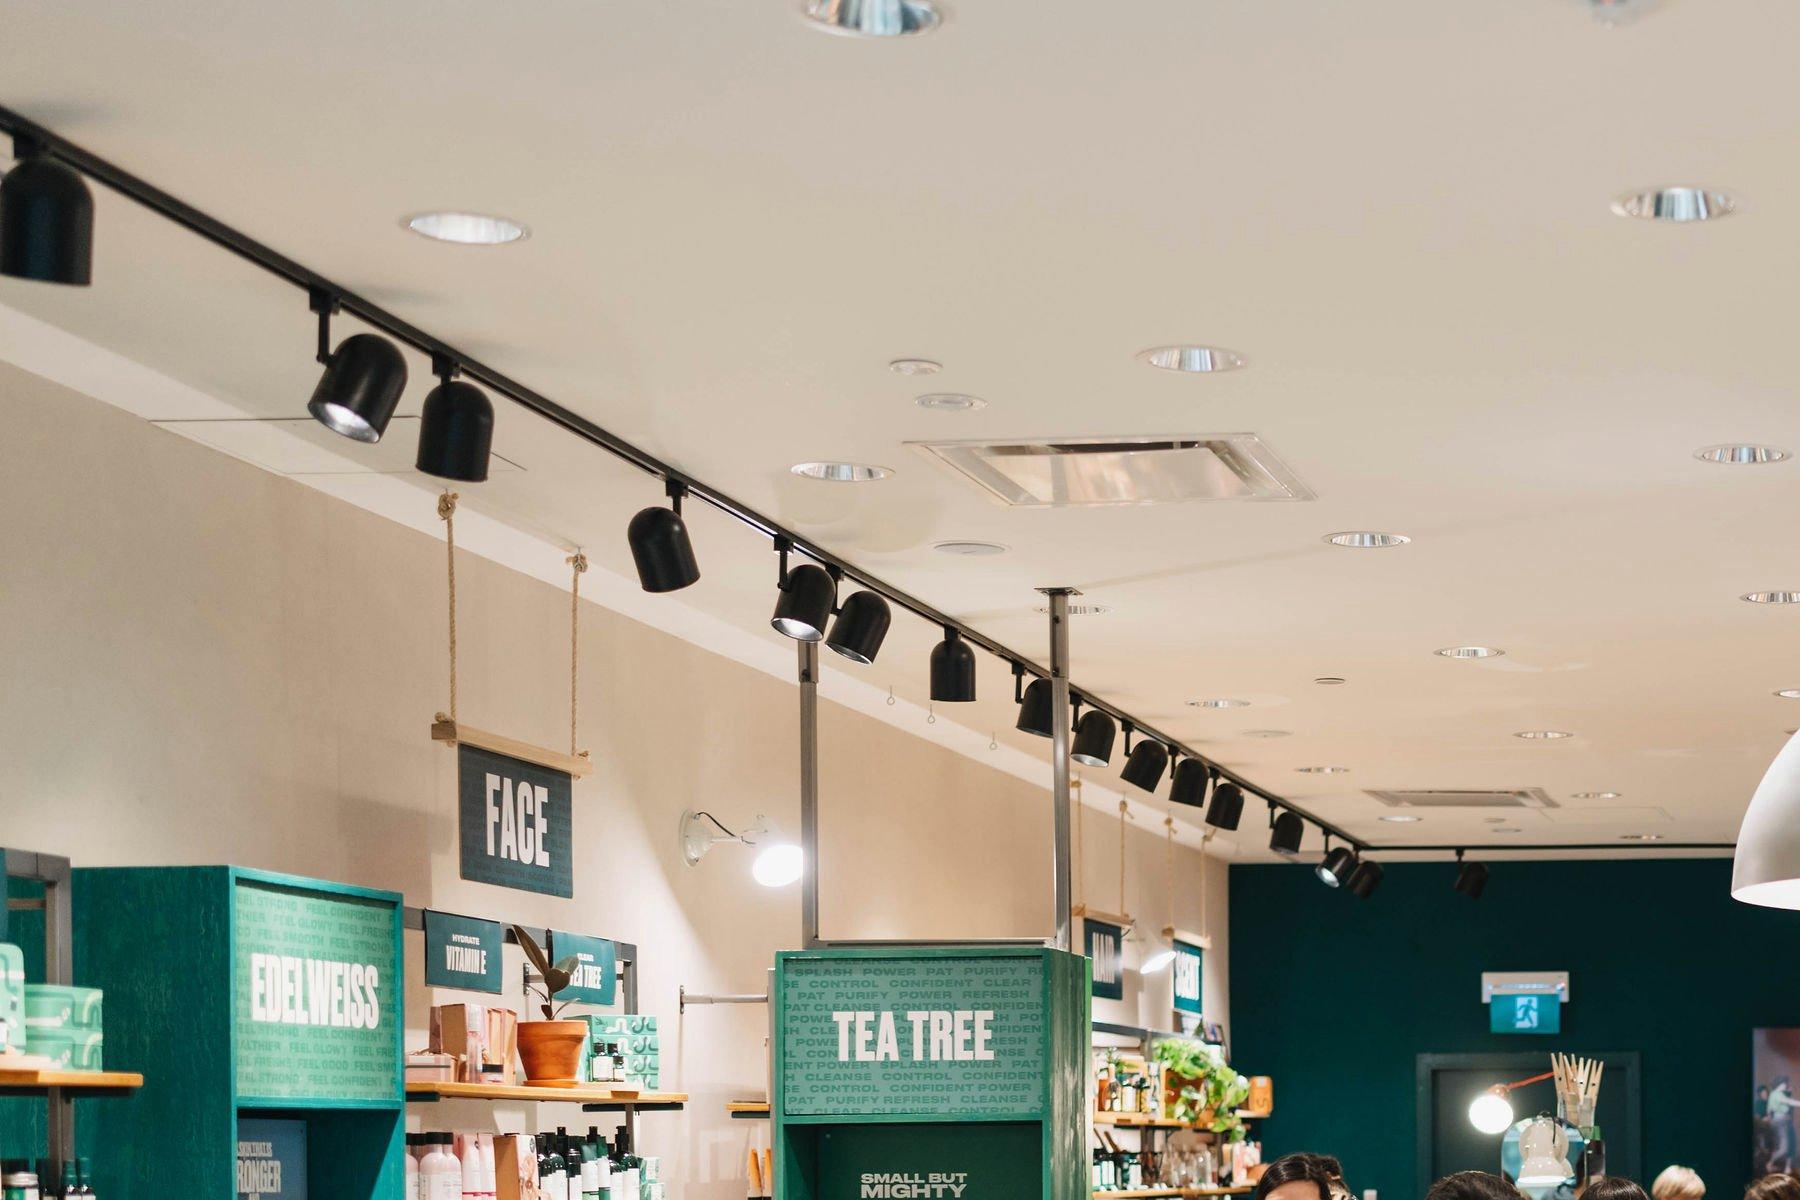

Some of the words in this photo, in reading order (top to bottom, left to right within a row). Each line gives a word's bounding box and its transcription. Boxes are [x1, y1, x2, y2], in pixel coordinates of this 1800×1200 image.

[486, 772, 549, 868] FACE
[452, 933, 480, 946] HYDRATE
[446, 945, 479, 974] VITAMIN
[480, 950, 487, 975] E
[863, 967, 916, 976] POWER
[926, 967, 954, 976] PAT
[965, 967, 1017, 976] PURIFY
[809, 979, 879, 989] CONTROL
[889, 978, 973, 988] CONFIDENT
[983, 978, 1032, 987] CLEAR
[252, 952, 380, 1030] EDELWEISS
[797, 992, 825, 1000] PAT
[835, 991, 888, 1000] PURIFY
[899, 991, 953, 1000] POWER
[962, 990, 1030, 1000] REFRESH
[814, 1002, 880, 1012] CLEANSE
[832, 1011, 900, 1062] TEA
[907, 1010, 995, 1061] TREE
[817, 1061, 870, 1070] POWER
[880, 1060, 938, 1069] SPLASH
[948, 1060, 1002, 1068] POWER
[1012, 1060, 1039, 1068] PAT
[805, 1073, 872, 1081] CLEANSE
[882, 1072, 956, 1081] CONTROL
[810, 1084, 880, 1093] CONTROL
[889, 1083, 973, 1092] CONFIDENT
[978, 1083, 1032, 1091] POWER
[788, 1096, 815, 1105] PAT
[826, 1095, 878, 1105] PURIFY
[883, 1095, 951, 1104] REFRESH
[960, 1095, 1028, 1103] CLEANSE
[861, 1173, 925, 1184] SMALL
[928, 1172, 968, 1183] BUT
[861, 1184, 968, 1199] MIGHTY
